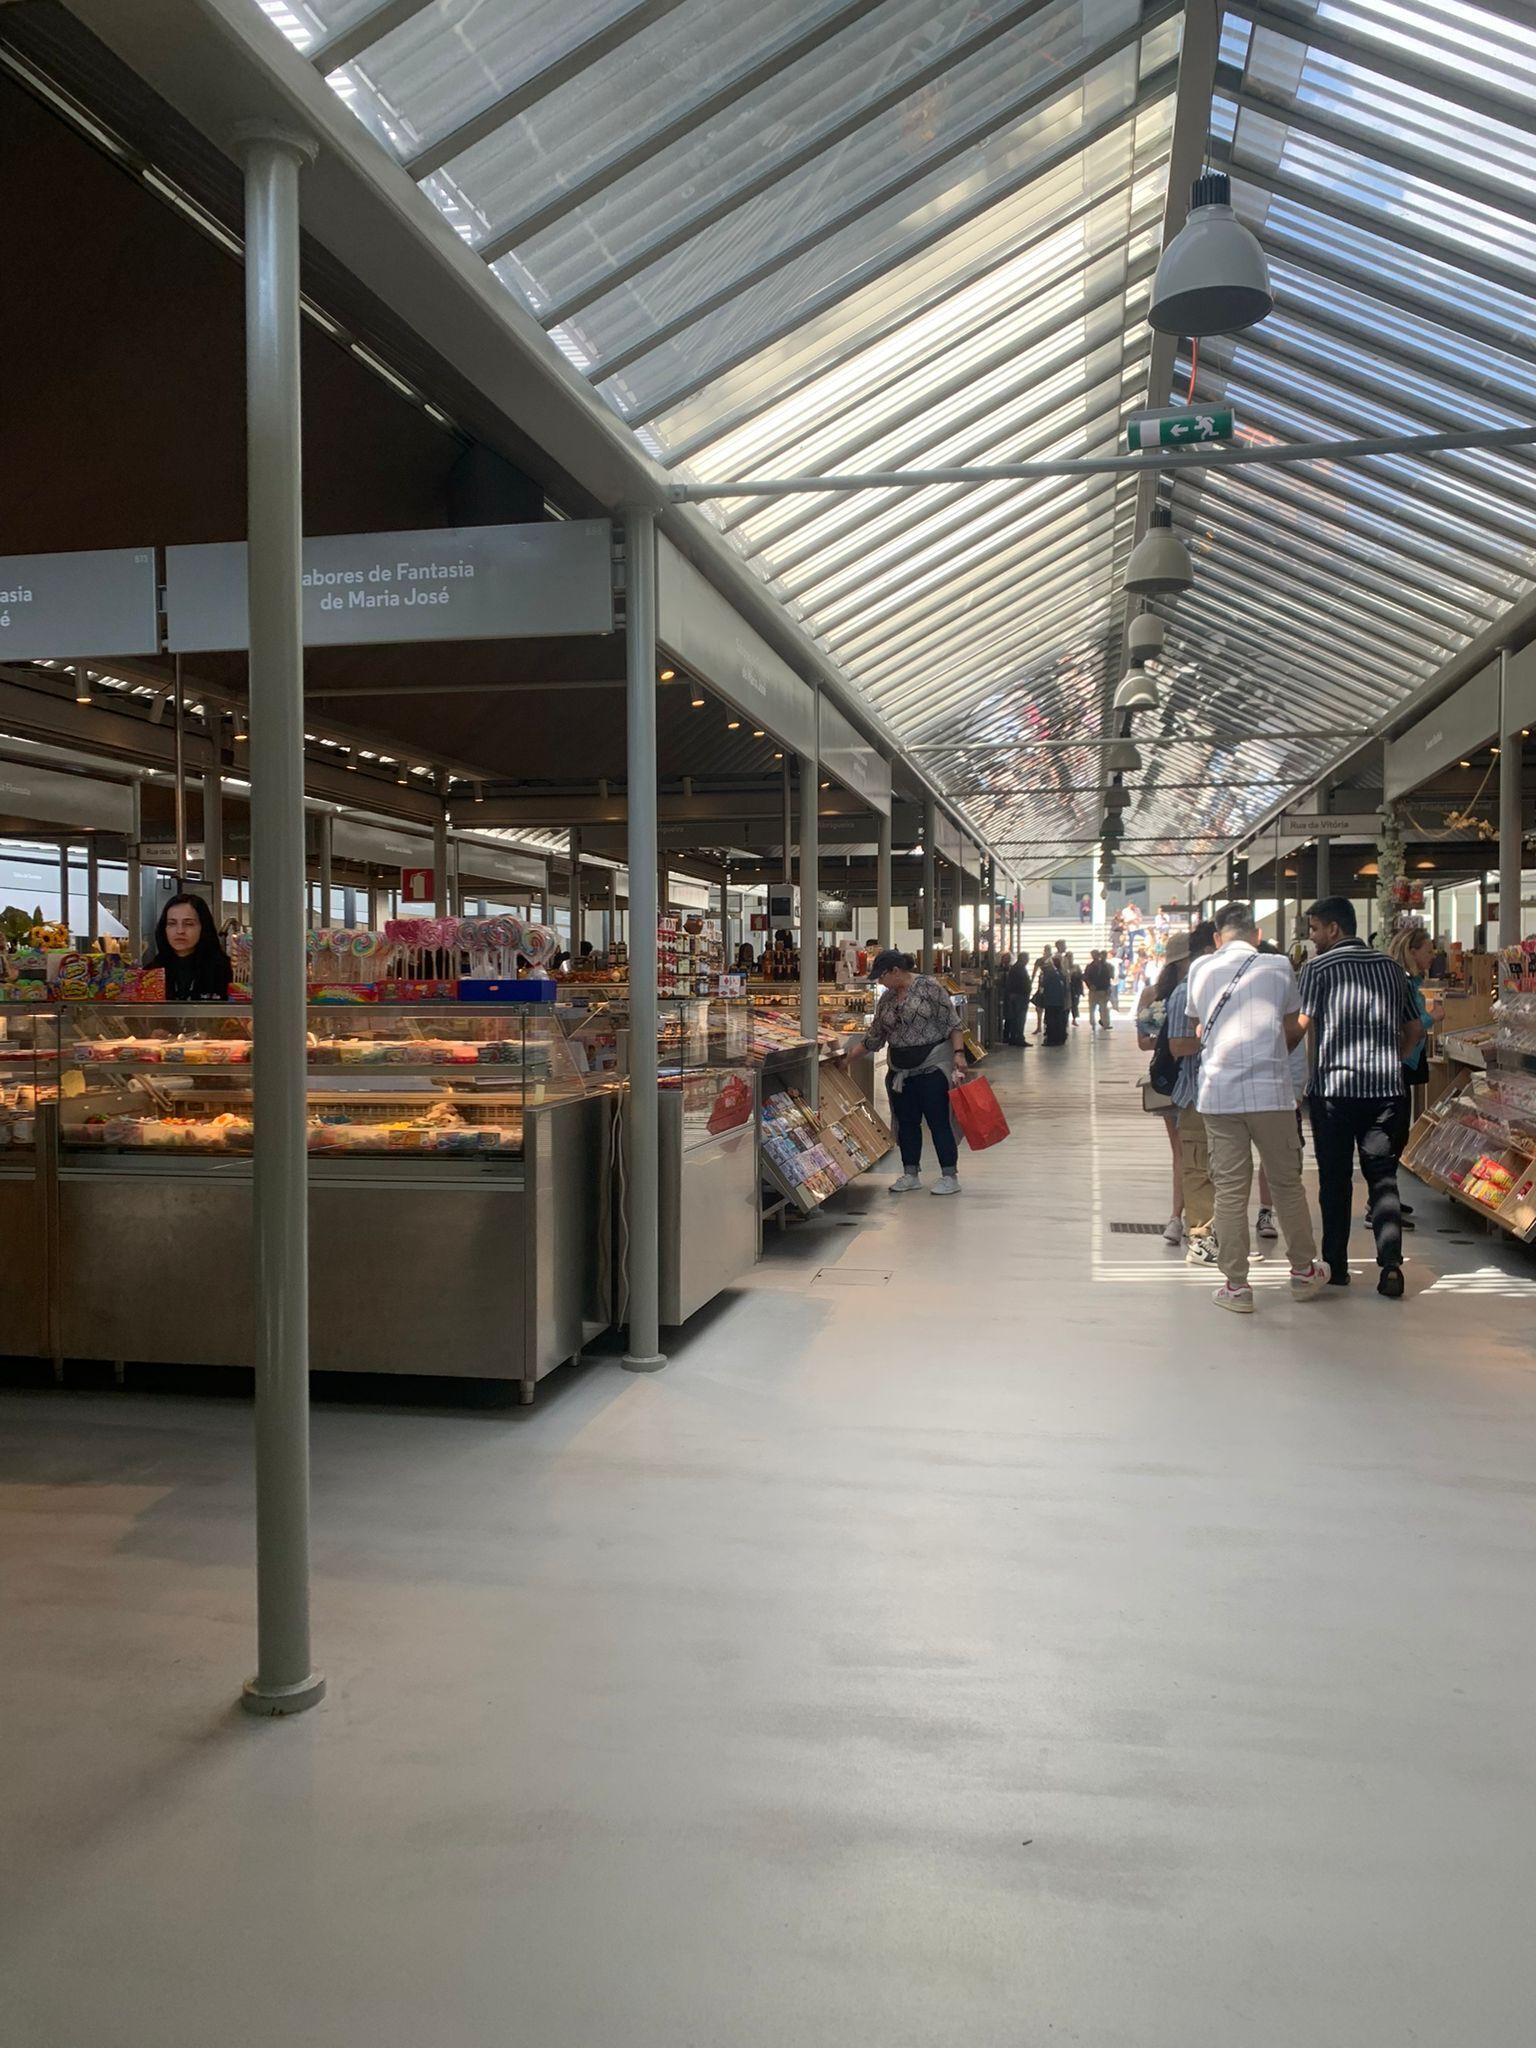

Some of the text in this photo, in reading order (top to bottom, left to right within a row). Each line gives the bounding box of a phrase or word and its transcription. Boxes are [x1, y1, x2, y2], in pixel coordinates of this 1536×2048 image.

[302, 560, 475, 586] abores de Fantasia
[0, 586, 33, 602] asia
[320, 586, 450, 610] de Maria José
